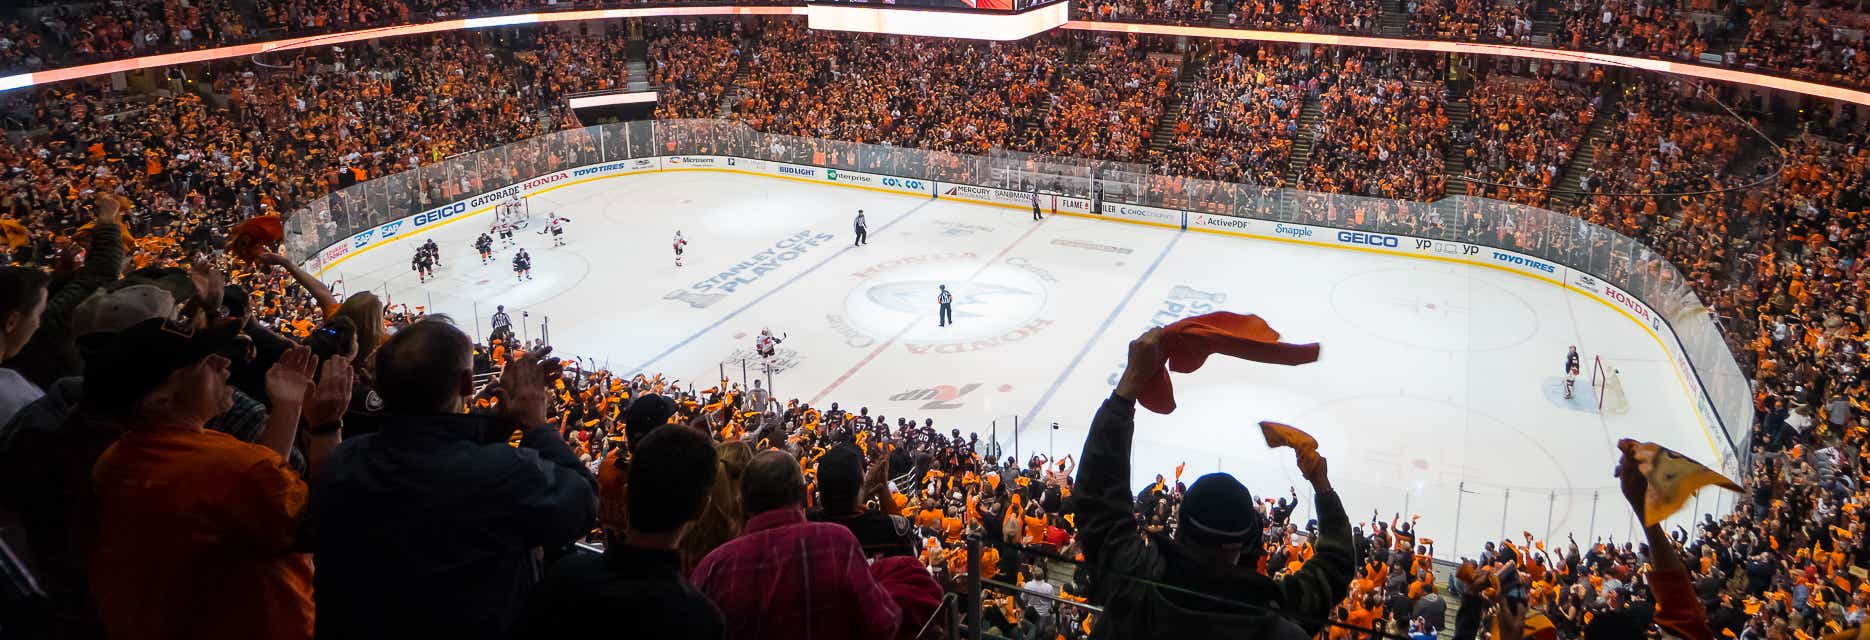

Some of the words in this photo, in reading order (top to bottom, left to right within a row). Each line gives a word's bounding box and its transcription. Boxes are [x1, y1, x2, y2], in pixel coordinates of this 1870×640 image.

[573, 167, 598, 177] TOYO
[599, 162, 625, 173] TIRES
[780, 166, 794, 174] BUD
[794, 168, 816, 176] LIGHT
[523, 172, 569, 191] HONDA
[471, 186, 520, 208] GATORADE
[958, 186, 990, 195] MERCURY
[1063, 199, 1083, 209] FLAME
[1102, 204, 1115, 213] ILER
[414, 202, 465, 227] GEICO
[1208, 217, 1247, 229] ActivePDF
[1275, 224, 1312, 237] Snapple
[1337, 231, 1399, 248] GEICO
[1416, 239, 1431, 250] yp
[1463, 244, 1479, 255] yp
[692, 248, 774, 292] STANLEY
[776, 230, 811, 249] CUP
[719, 233, 834, 293] PLAYOFFS
[1493, 251, 1524, 265] TOYO
[1524, 260, 1556, 273] TIRES
[1605, 287, 1650, 321] HONDA
